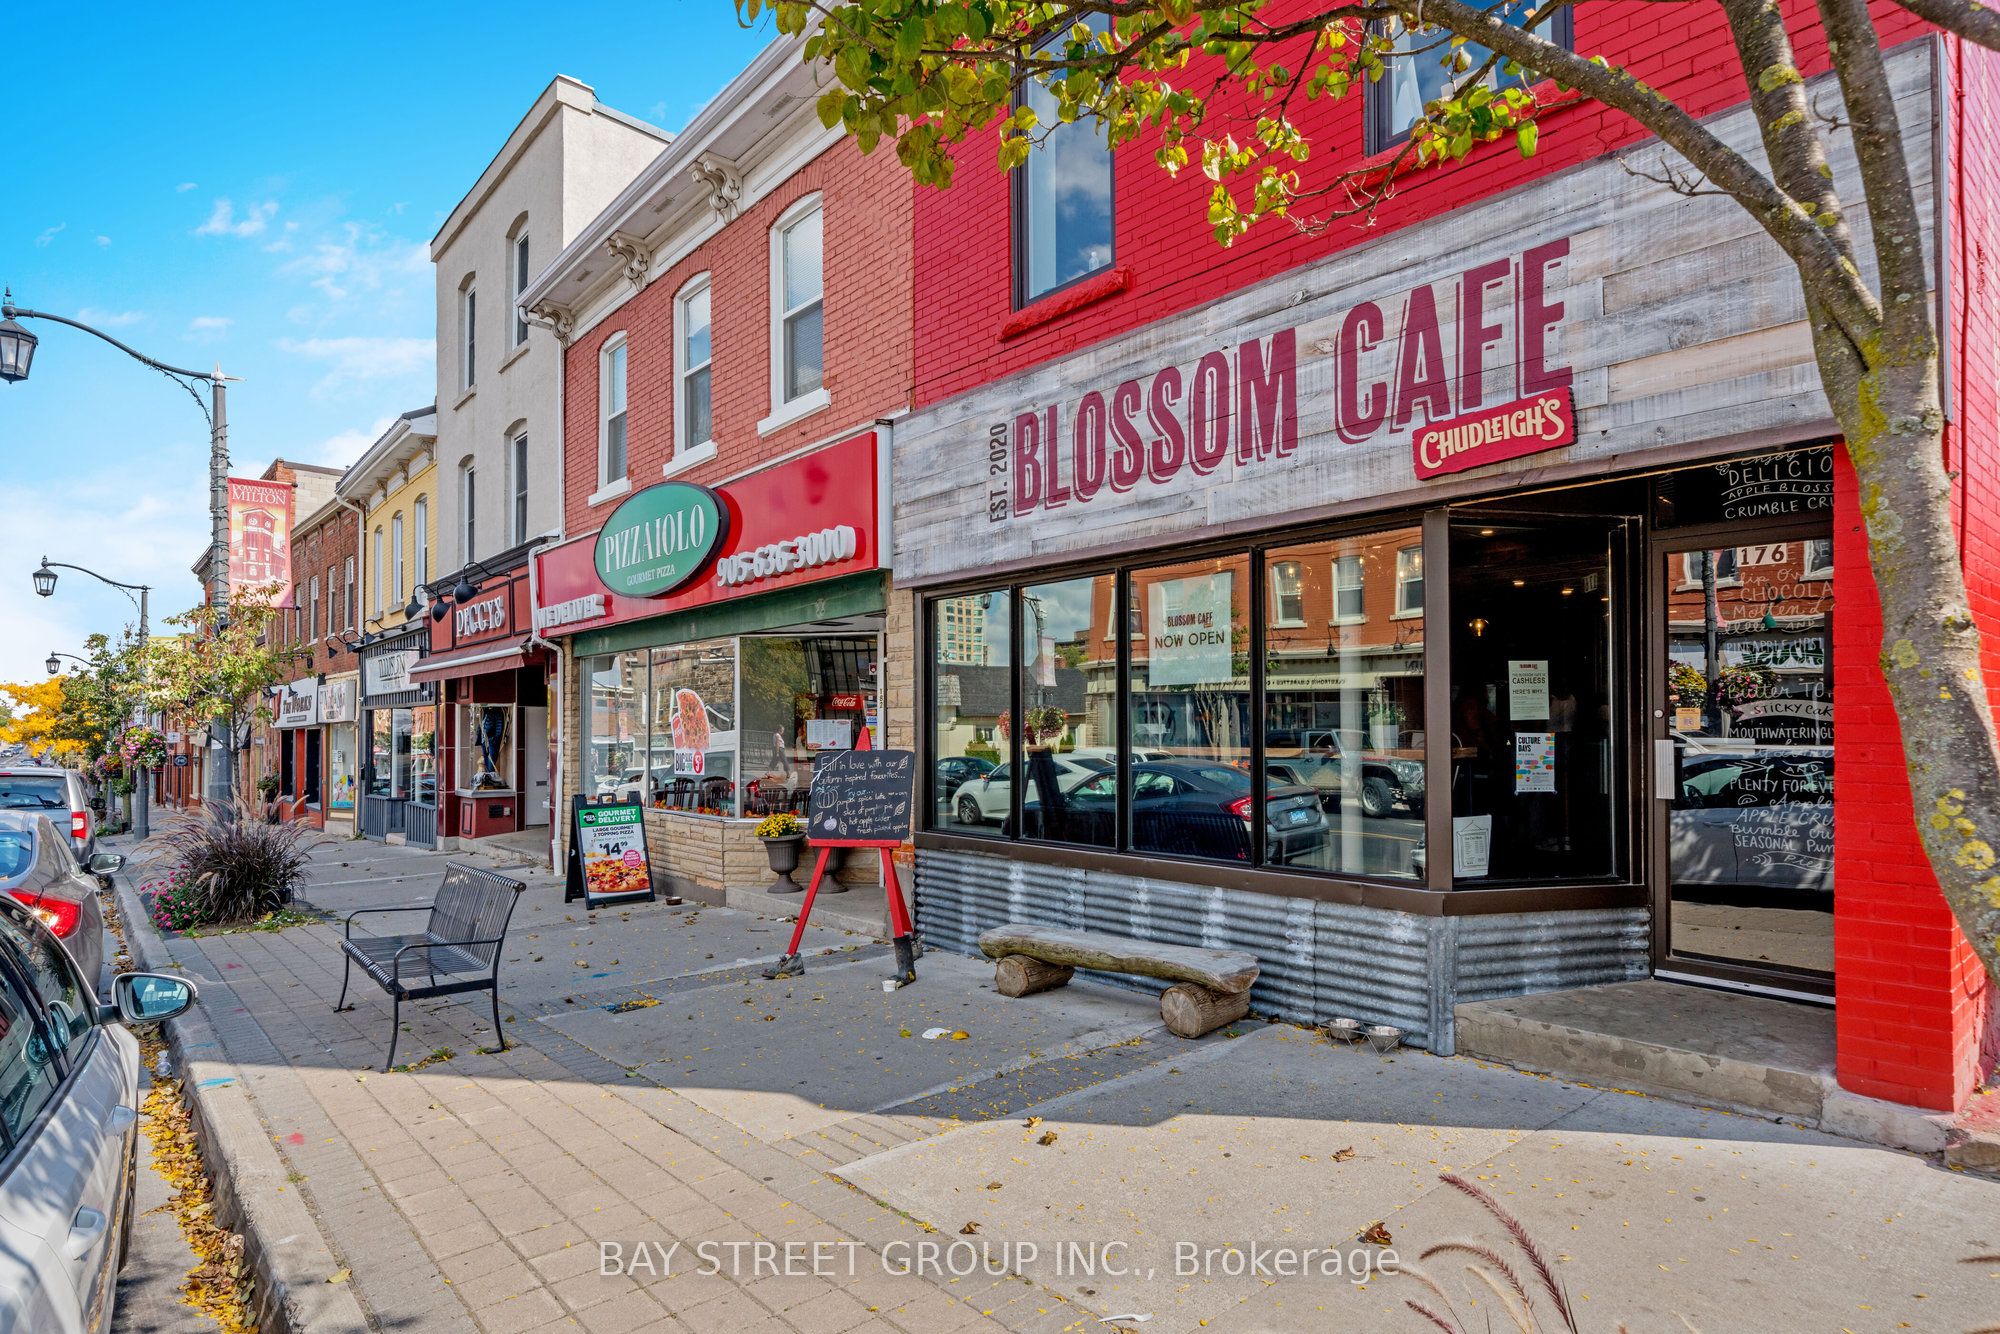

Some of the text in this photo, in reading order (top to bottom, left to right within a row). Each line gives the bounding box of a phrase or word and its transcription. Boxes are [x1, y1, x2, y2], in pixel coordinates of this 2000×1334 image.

[1013, 237, 1574, 519] BLOSSOM CAFE
[1420, 398, 1565, 469] CHUDLEIGH'S
[989, 422, 1007, 523] EST. 2020
[231, 489, 286, 505] MILTON
[232, 484, 286, 496] DOWNTOWN
[1728, 482, 1834, 500] APPLE BLOSS
[1724, 499, 1799, 519] CRUMBLE
[604, 504, 705, 573] PIZZAIOLO
[717, 524, 856, 587] 905-636-3000
[1740, 544, 1785, 566] 176
[626, 564, 675, 586] GOURMET PIZZA
[1168, 613, 1196, 627] BLOSSOM
[1155, 630, 1225, 649] NOW OPEN
[1518, 736, 1541, 744] CULTURE
[821, 755, 837, 772] Fall
[839, 761, 846, 770] in
[849, 755, 865, 769] love
[867, 757, 882, 769] with
[1730, 778, 1778, 793] PLENTY
[597, 808, 636, 817] GOURMET
[598, 815, 636, 823] DELIVERY
[1735, 808, 1790, 824] APPLE
[1735, 835, 1797, 850] SEASONAL
